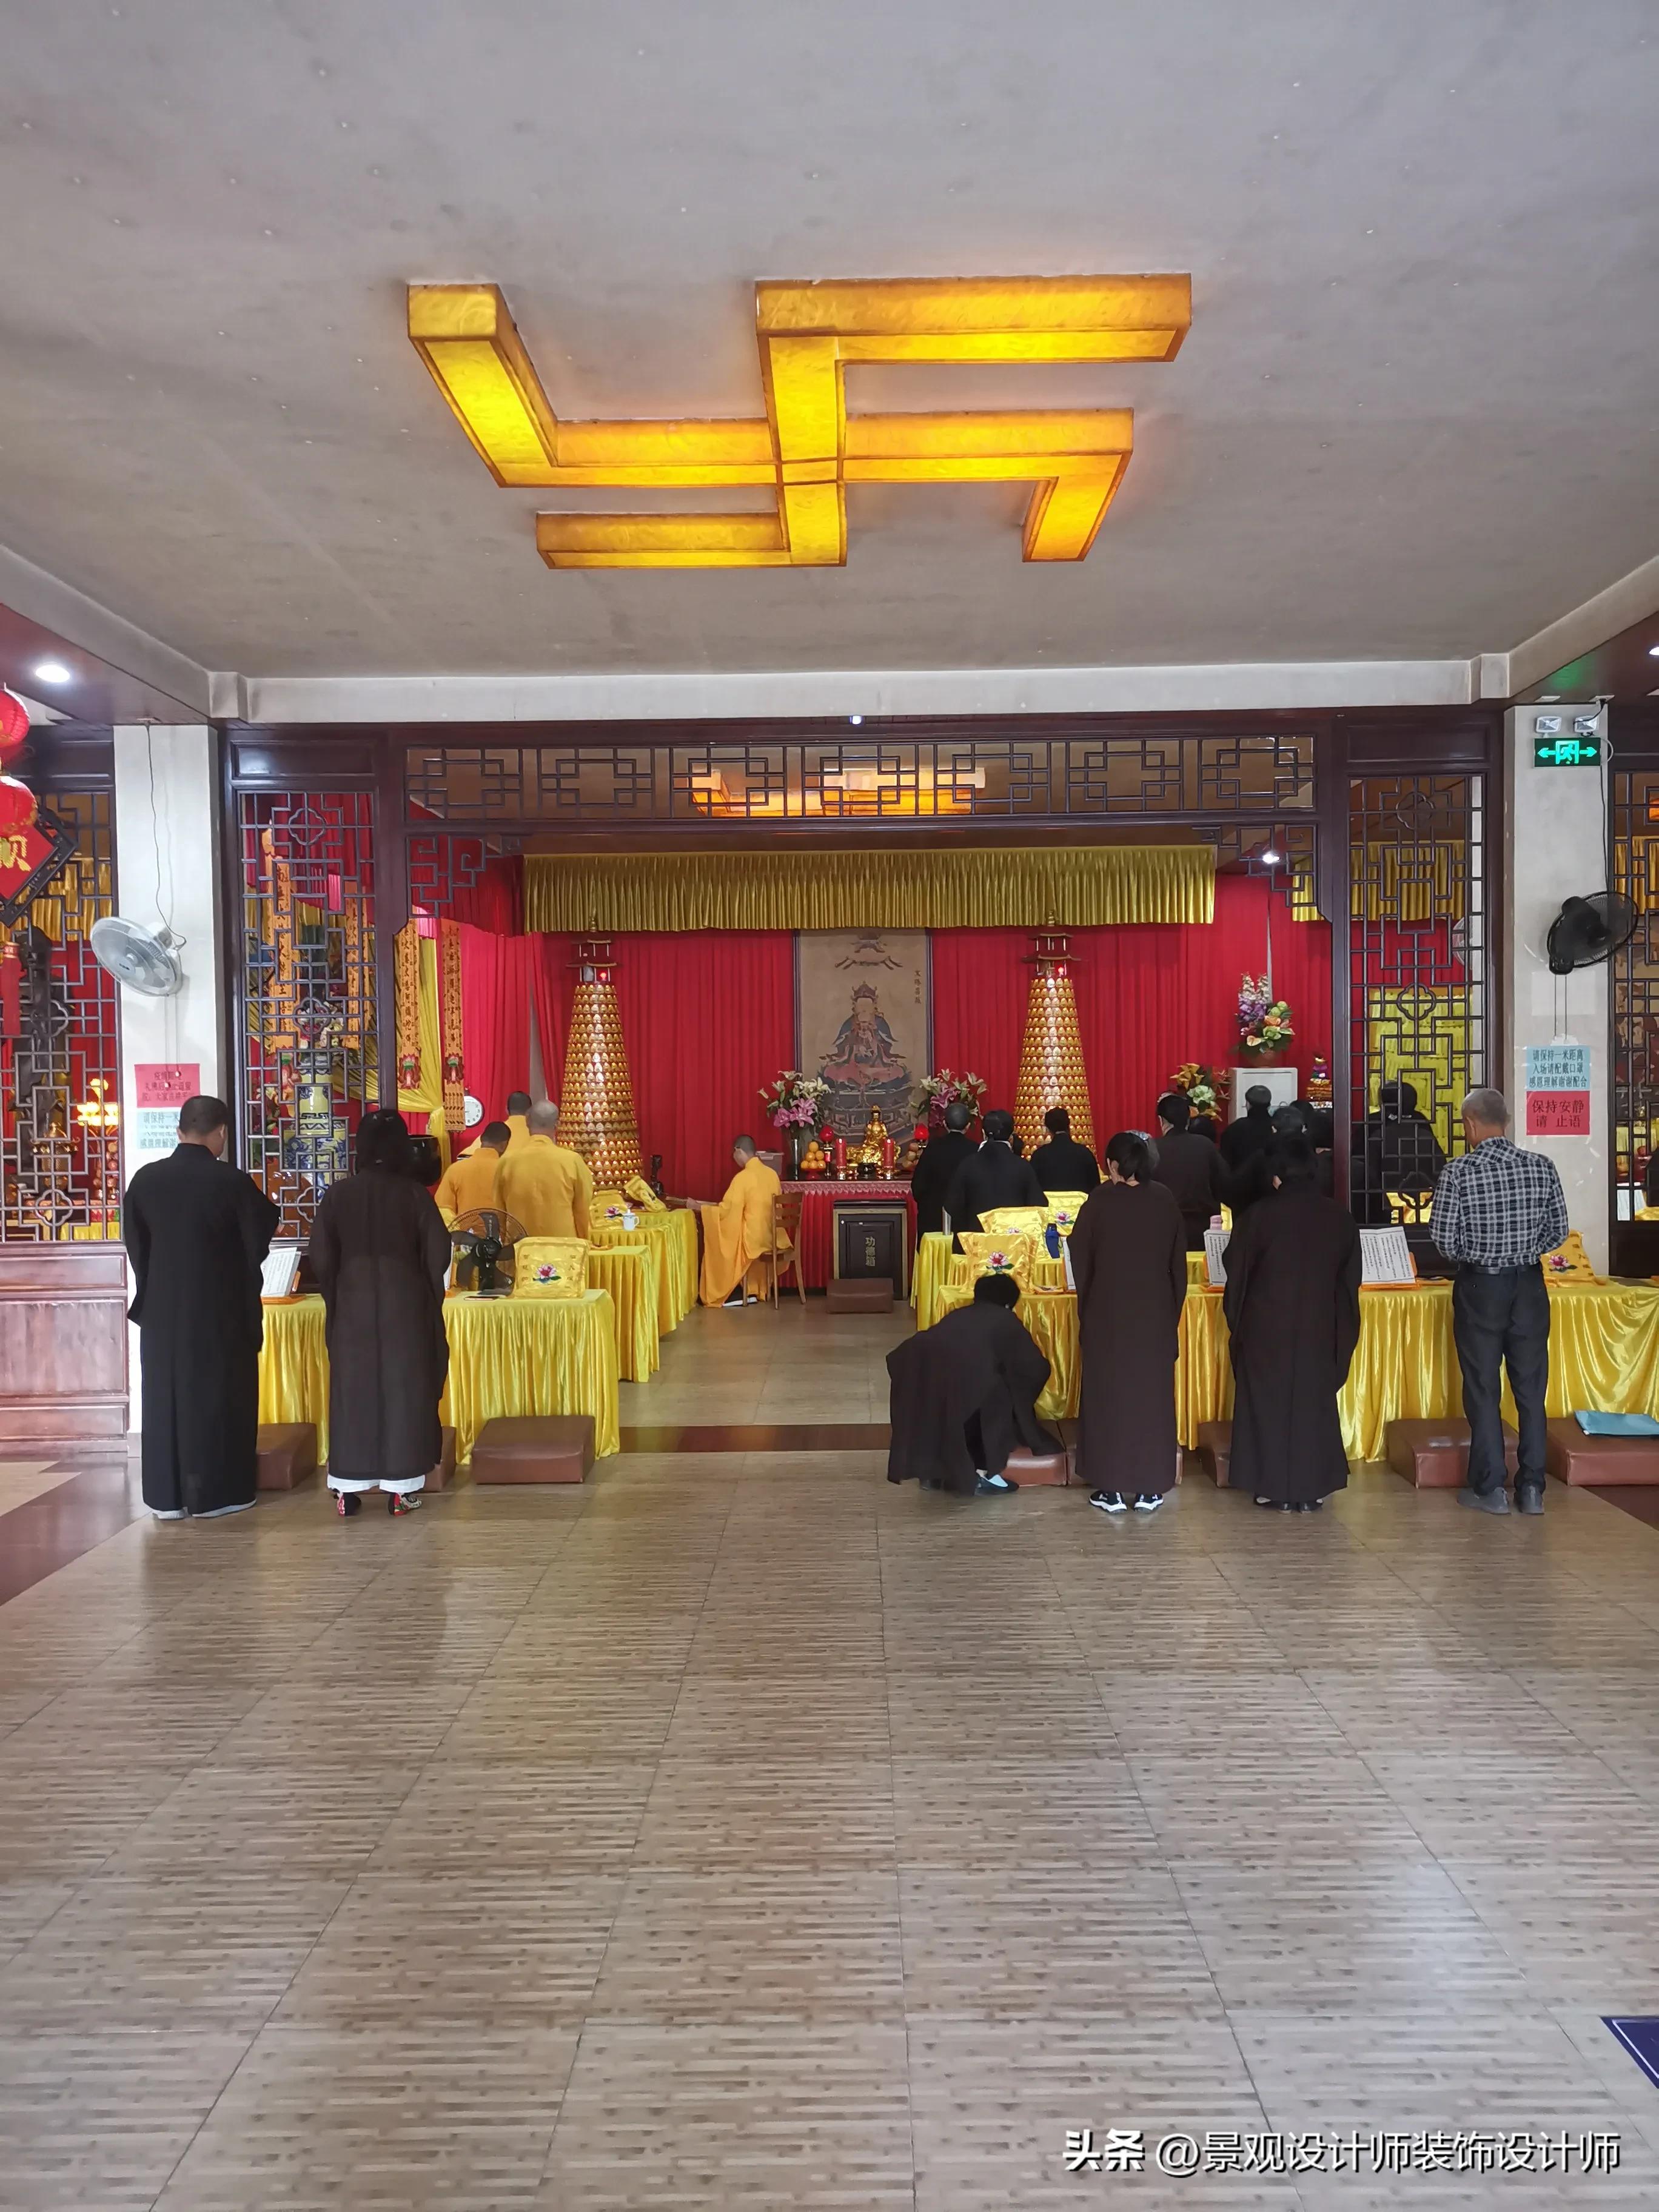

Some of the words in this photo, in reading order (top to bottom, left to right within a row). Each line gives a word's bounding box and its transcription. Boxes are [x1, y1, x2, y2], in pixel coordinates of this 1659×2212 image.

[1533, 1049, 1583, 1061] 请保持一米距离
[1532, 1100, 1584, 1113] 保持安静
[1537, 1116, 1547, 1127] 请
[1556, 1115, 1581, 1128] 止语
[865, 1236, 876, 1267] 功德箱
